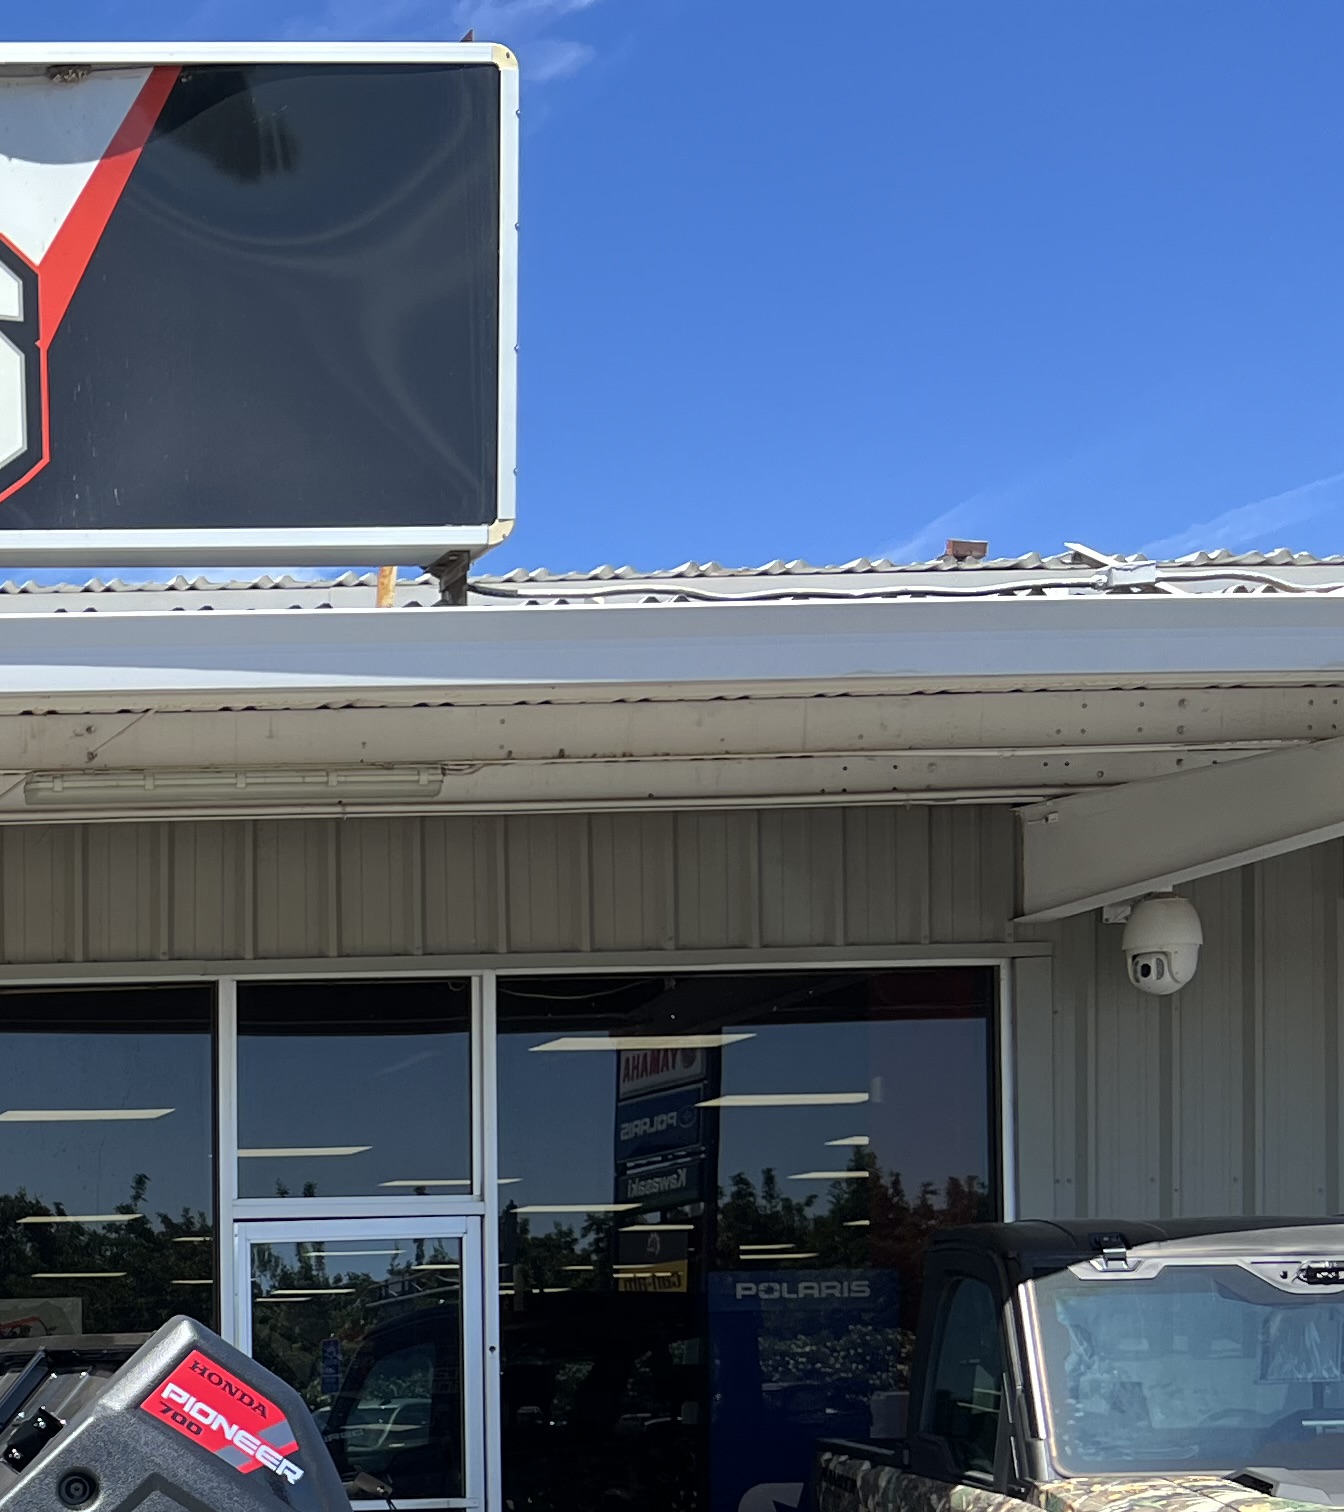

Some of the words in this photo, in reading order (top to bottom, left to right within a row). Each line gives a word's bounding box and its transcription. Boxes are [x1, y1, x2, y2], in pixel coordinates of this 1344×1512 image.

[735, 1280, 871, 1301] POLARIS
[188, 1359, 268, 1420] HONDA
[158, 1400, 204, 1437] 700
[160, 1382, 305, 1486] PIONEER
